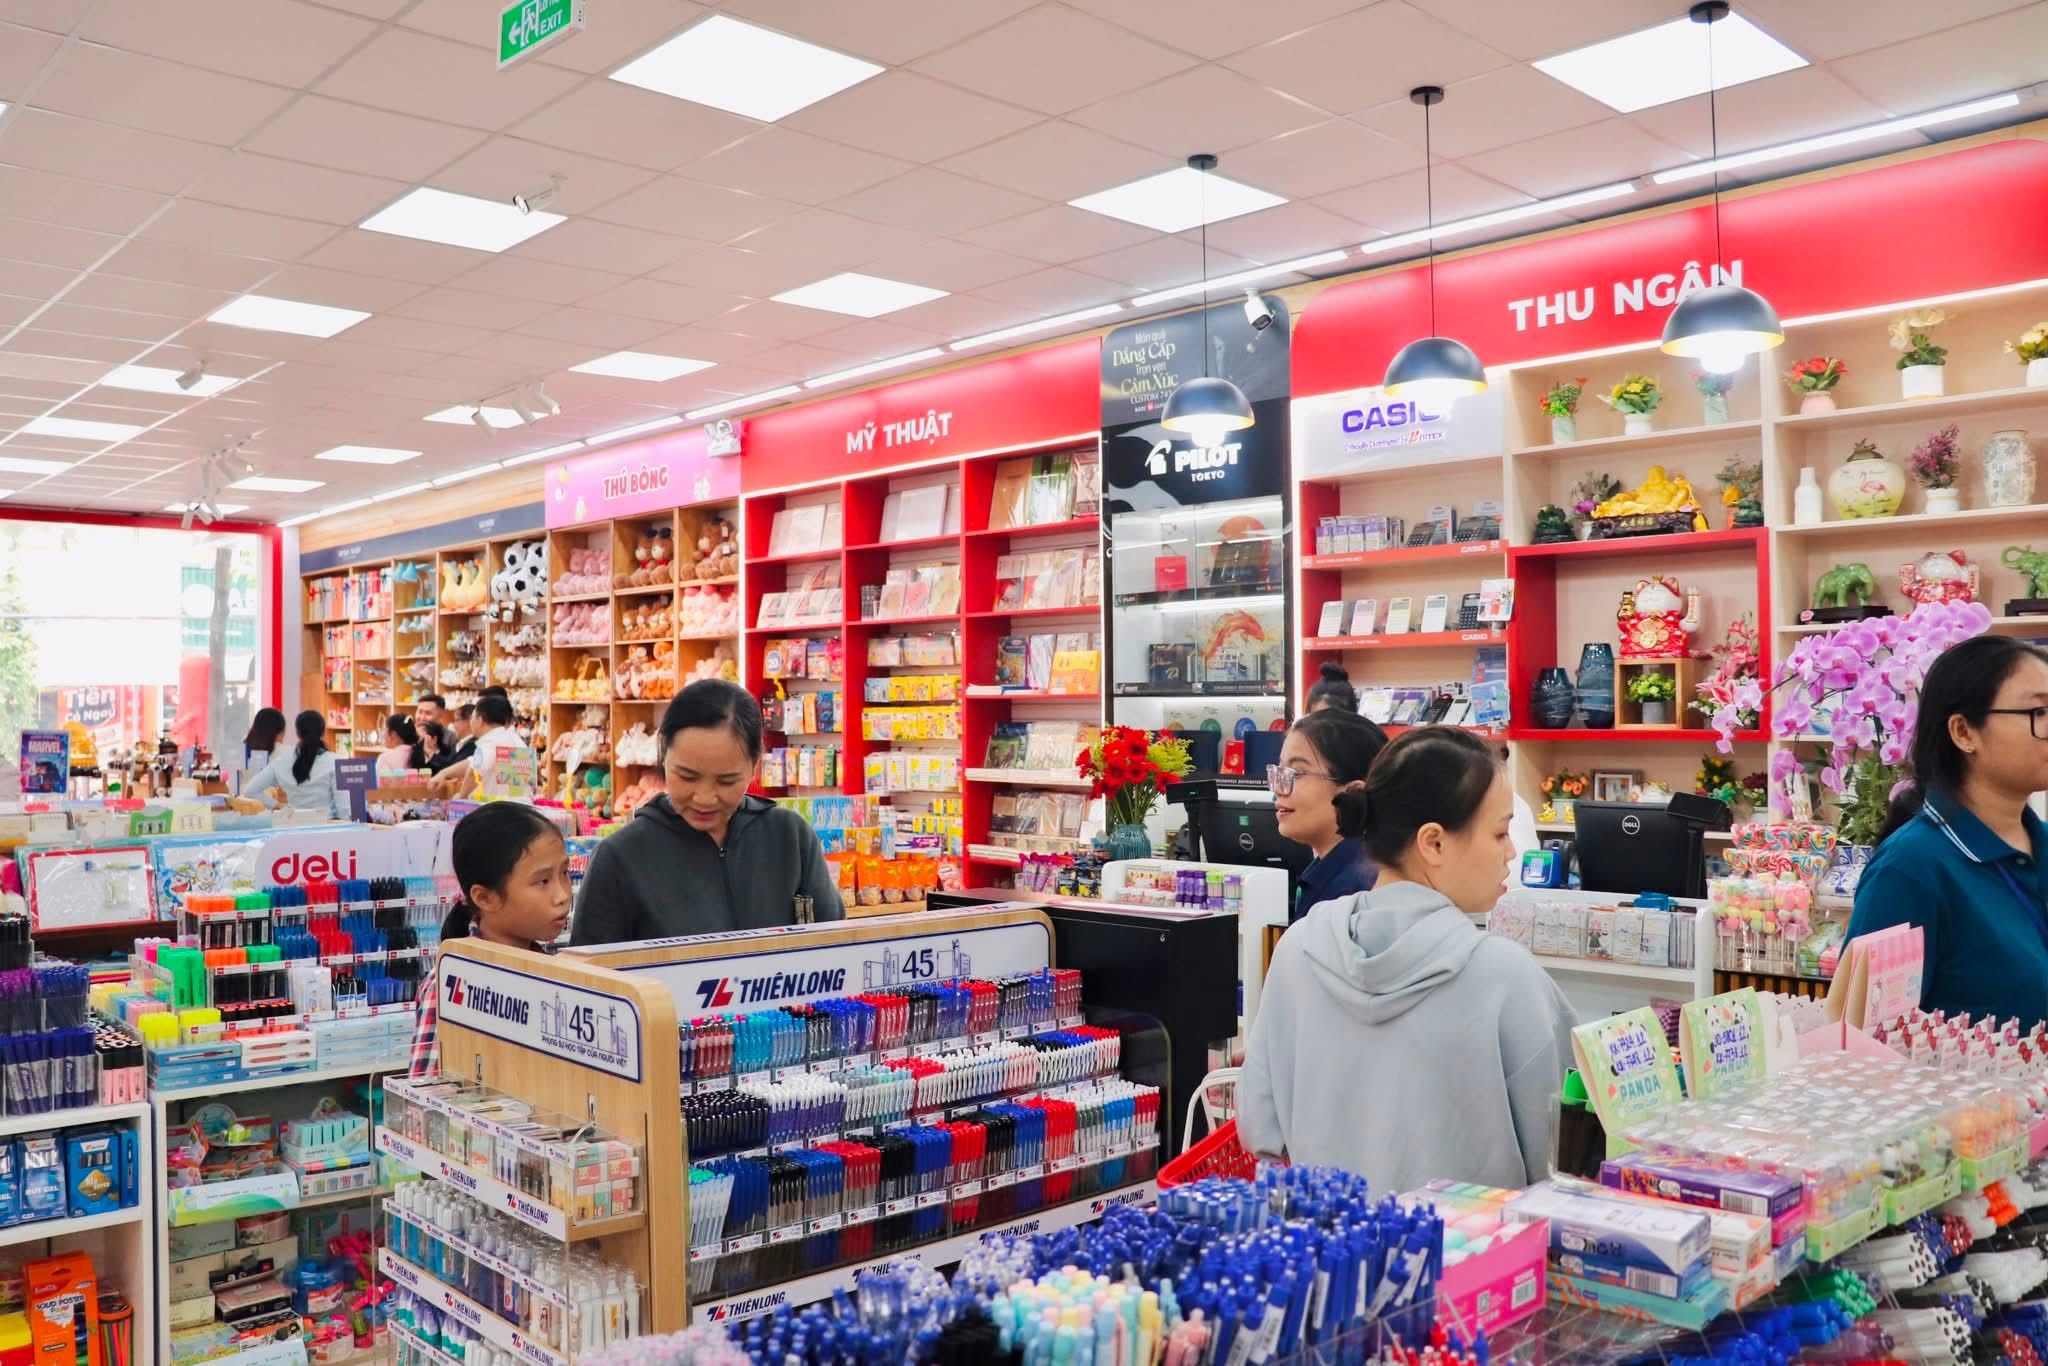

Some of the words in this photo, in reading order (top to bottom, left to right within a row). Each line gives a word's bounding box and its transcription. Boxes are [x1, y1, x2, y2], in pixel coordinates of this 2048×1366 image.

[540, 9, 563, 35] EXIT
[1509, 288, 1595, 331] THU
[1343, 400, 1440, 433] CASI
[846, 423, 876, 454] MỸ
[884, 411, 952, 445] THUẬT
[1174, 443, 1242, 473] PILOT
[603, 471, 628, 499] THÚ
[630, 464, 668, 492] BÔNG
[1191, 470, 1225, 482] TOKYO
[28, 740, 61, 753] MARVEL
[271, 849, 356, 885] deli
[902, 948, 934, 979] 45
[739, 968, 845, 1004] THIÊNLONG
[467, 984, 529, 1026] THIÊNLONG
[569, 1004, 595, 1043] 45
[1620, 1073, 1662, 1102] PANDA
[450, 1167, 477, 1190] THIÊNLONG
[517, 1200, 549, 1225] THIÊNLONG
[453, 1300, 481, 1325] THIÊNLONG
[728, 1291, 786, 1316] THIÊNLONG
